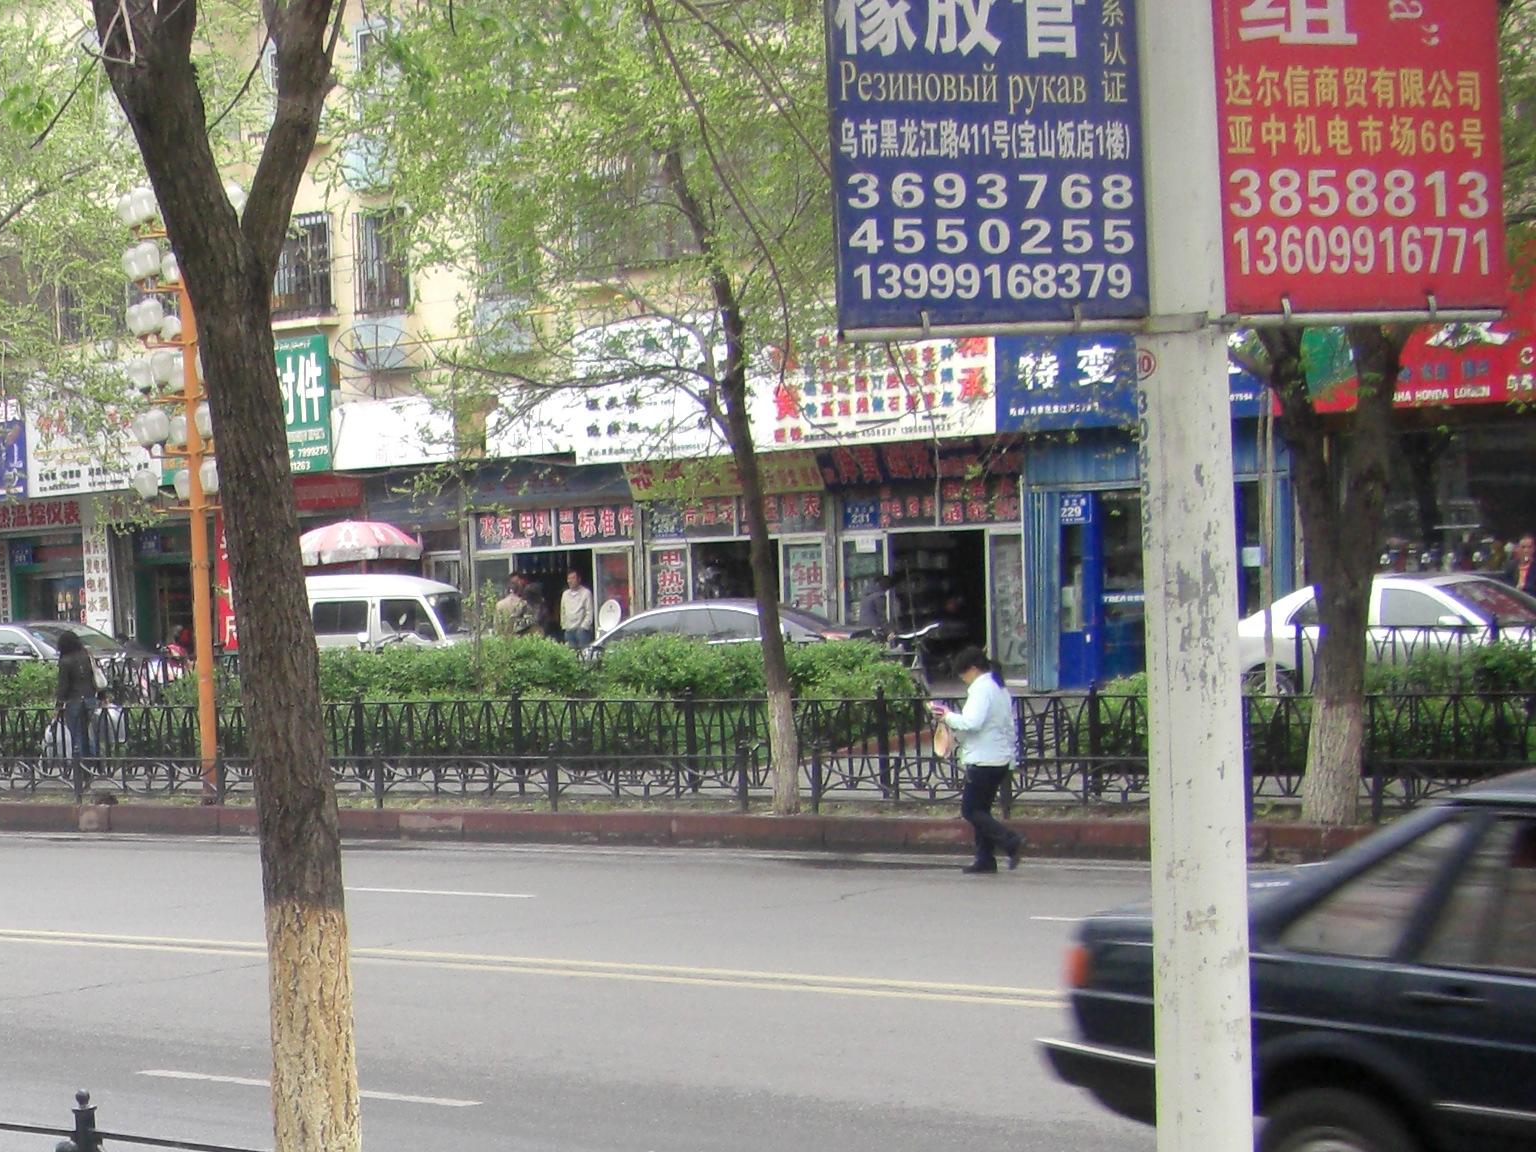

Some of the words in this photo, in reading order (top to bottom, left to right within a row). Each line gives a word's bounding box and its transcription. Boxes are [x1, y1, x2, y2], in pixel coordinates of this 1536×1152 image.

[839, 60, 999, 103] Резиновый
[1008, 73, 1088, 116] рукав
[1224, 64, 1481, 111] 达尔信商贸有限公司
[839, 118, 1131, 160] 乌市黑龙江路411号(宝山饭店1楼)
[1226, 113, 1486, 158] 亚中机电市场66号
[847, 172, 1134, 210] 3693768
[1228, 168, 1490, 220] 3858813
[848, 218, 1135, 254] 4550255
[1232, 226, 1490, 276] 13609916771
[852, 263, 1133, 299] 13999168379
